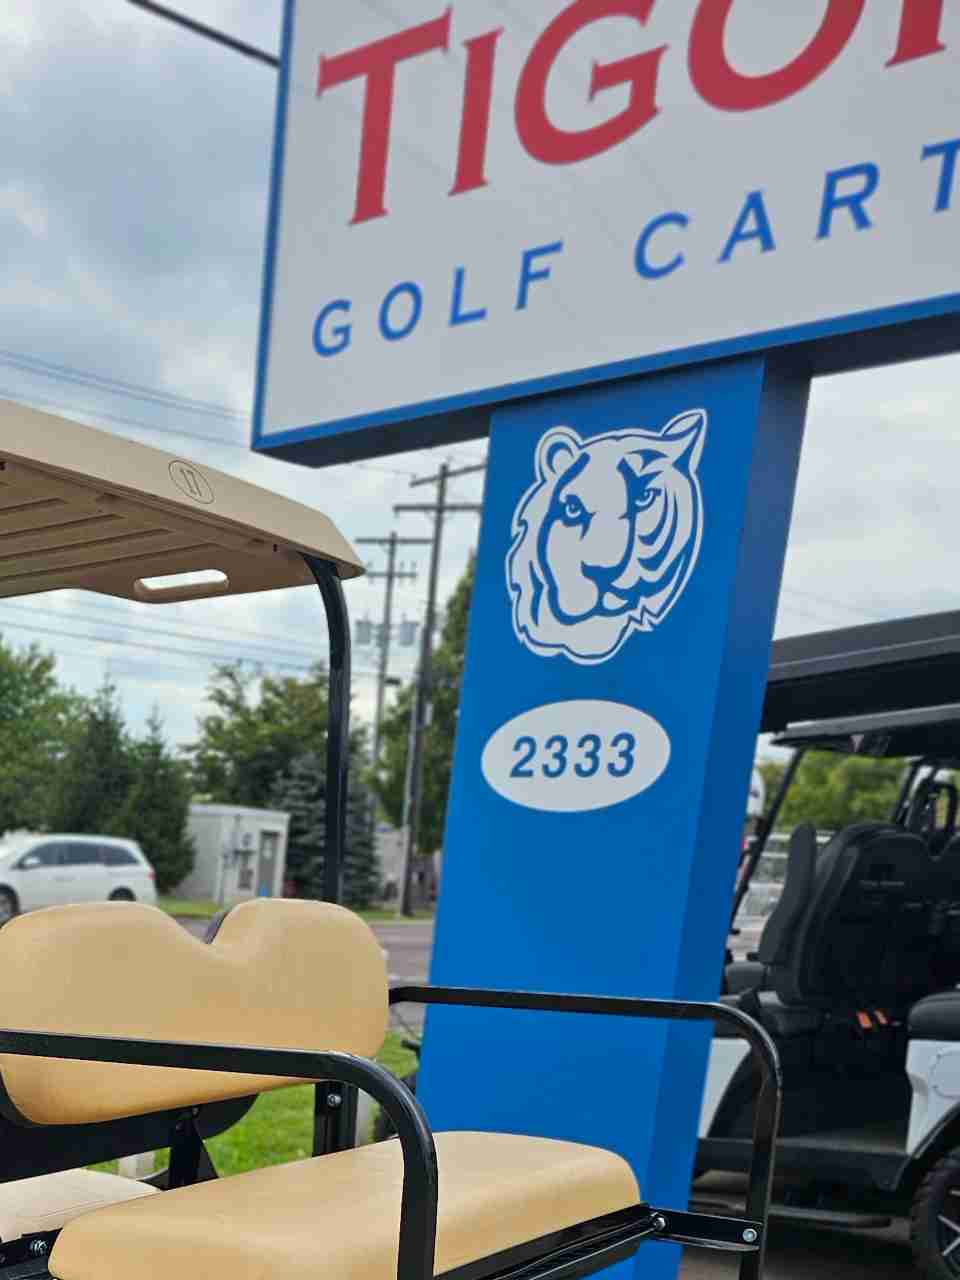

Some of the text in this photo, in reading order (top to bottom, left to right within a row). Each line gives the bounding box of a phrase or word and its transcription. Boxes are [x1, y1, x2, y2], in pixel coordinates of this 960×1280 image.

[316, 0, 947, 226] TIGO
[312, 137, 960, 357] GOLF CART
[509, 731, 637, 778] 2333
